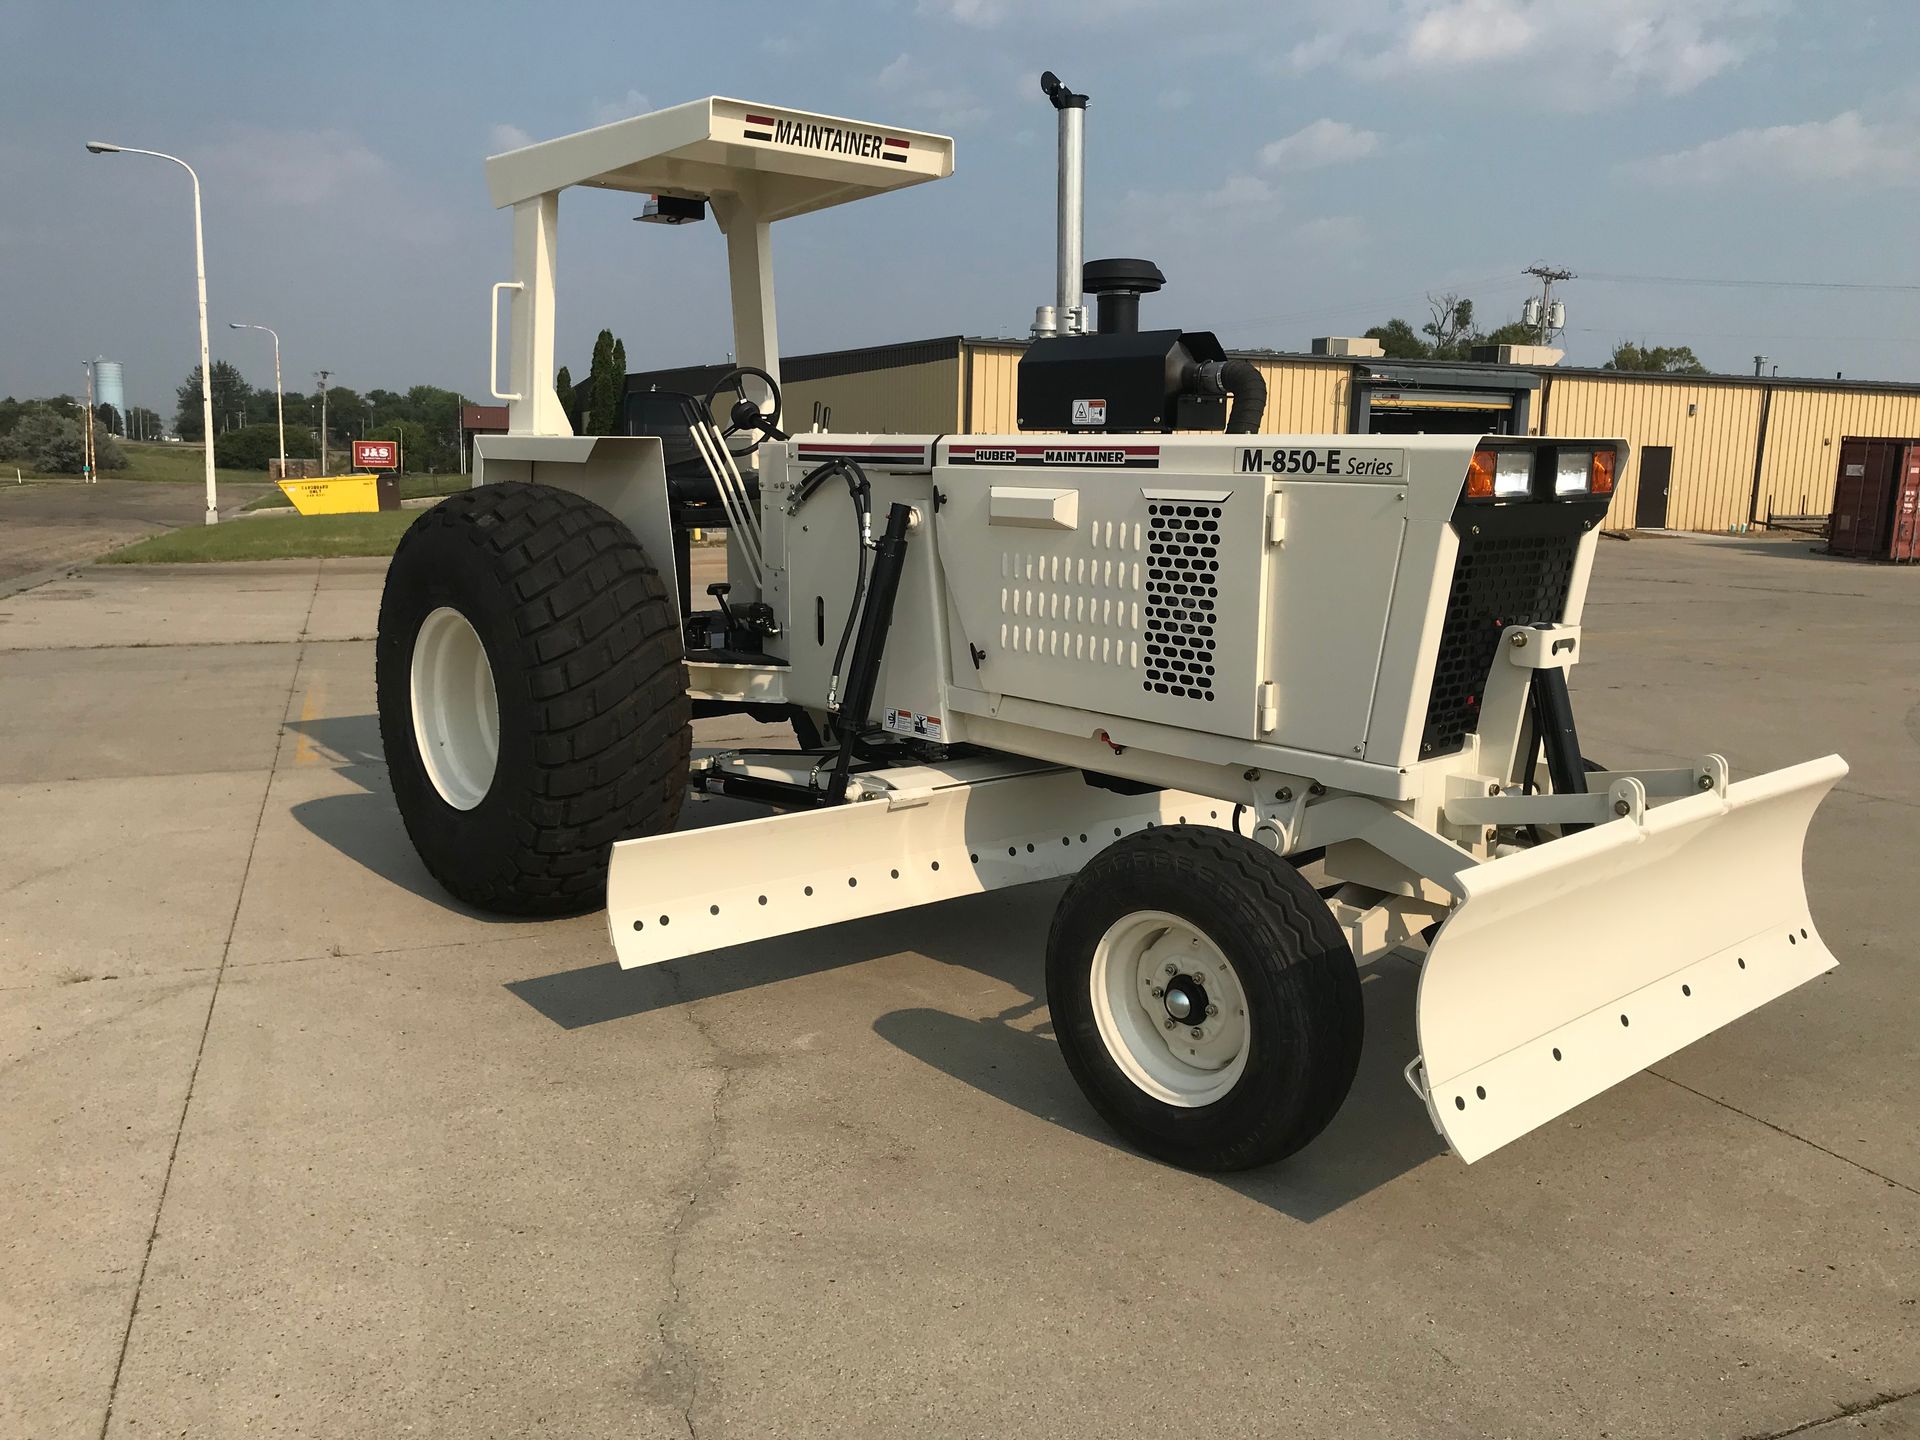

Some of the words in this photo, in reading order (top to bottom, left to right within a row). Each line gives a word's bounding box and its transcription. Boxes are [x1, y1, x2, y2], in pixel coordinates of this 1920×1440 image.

[774, 120, 882, 159] MAINTAINER
[362, 448, 389, 457] J&S
[976, 450, 1015, 461] HUBER
[1045, 451, 1124, 463] MAINTAINER
[1242, 449, 1341, 474] M-850-E
[1346, 457, 1393, 476] Series
